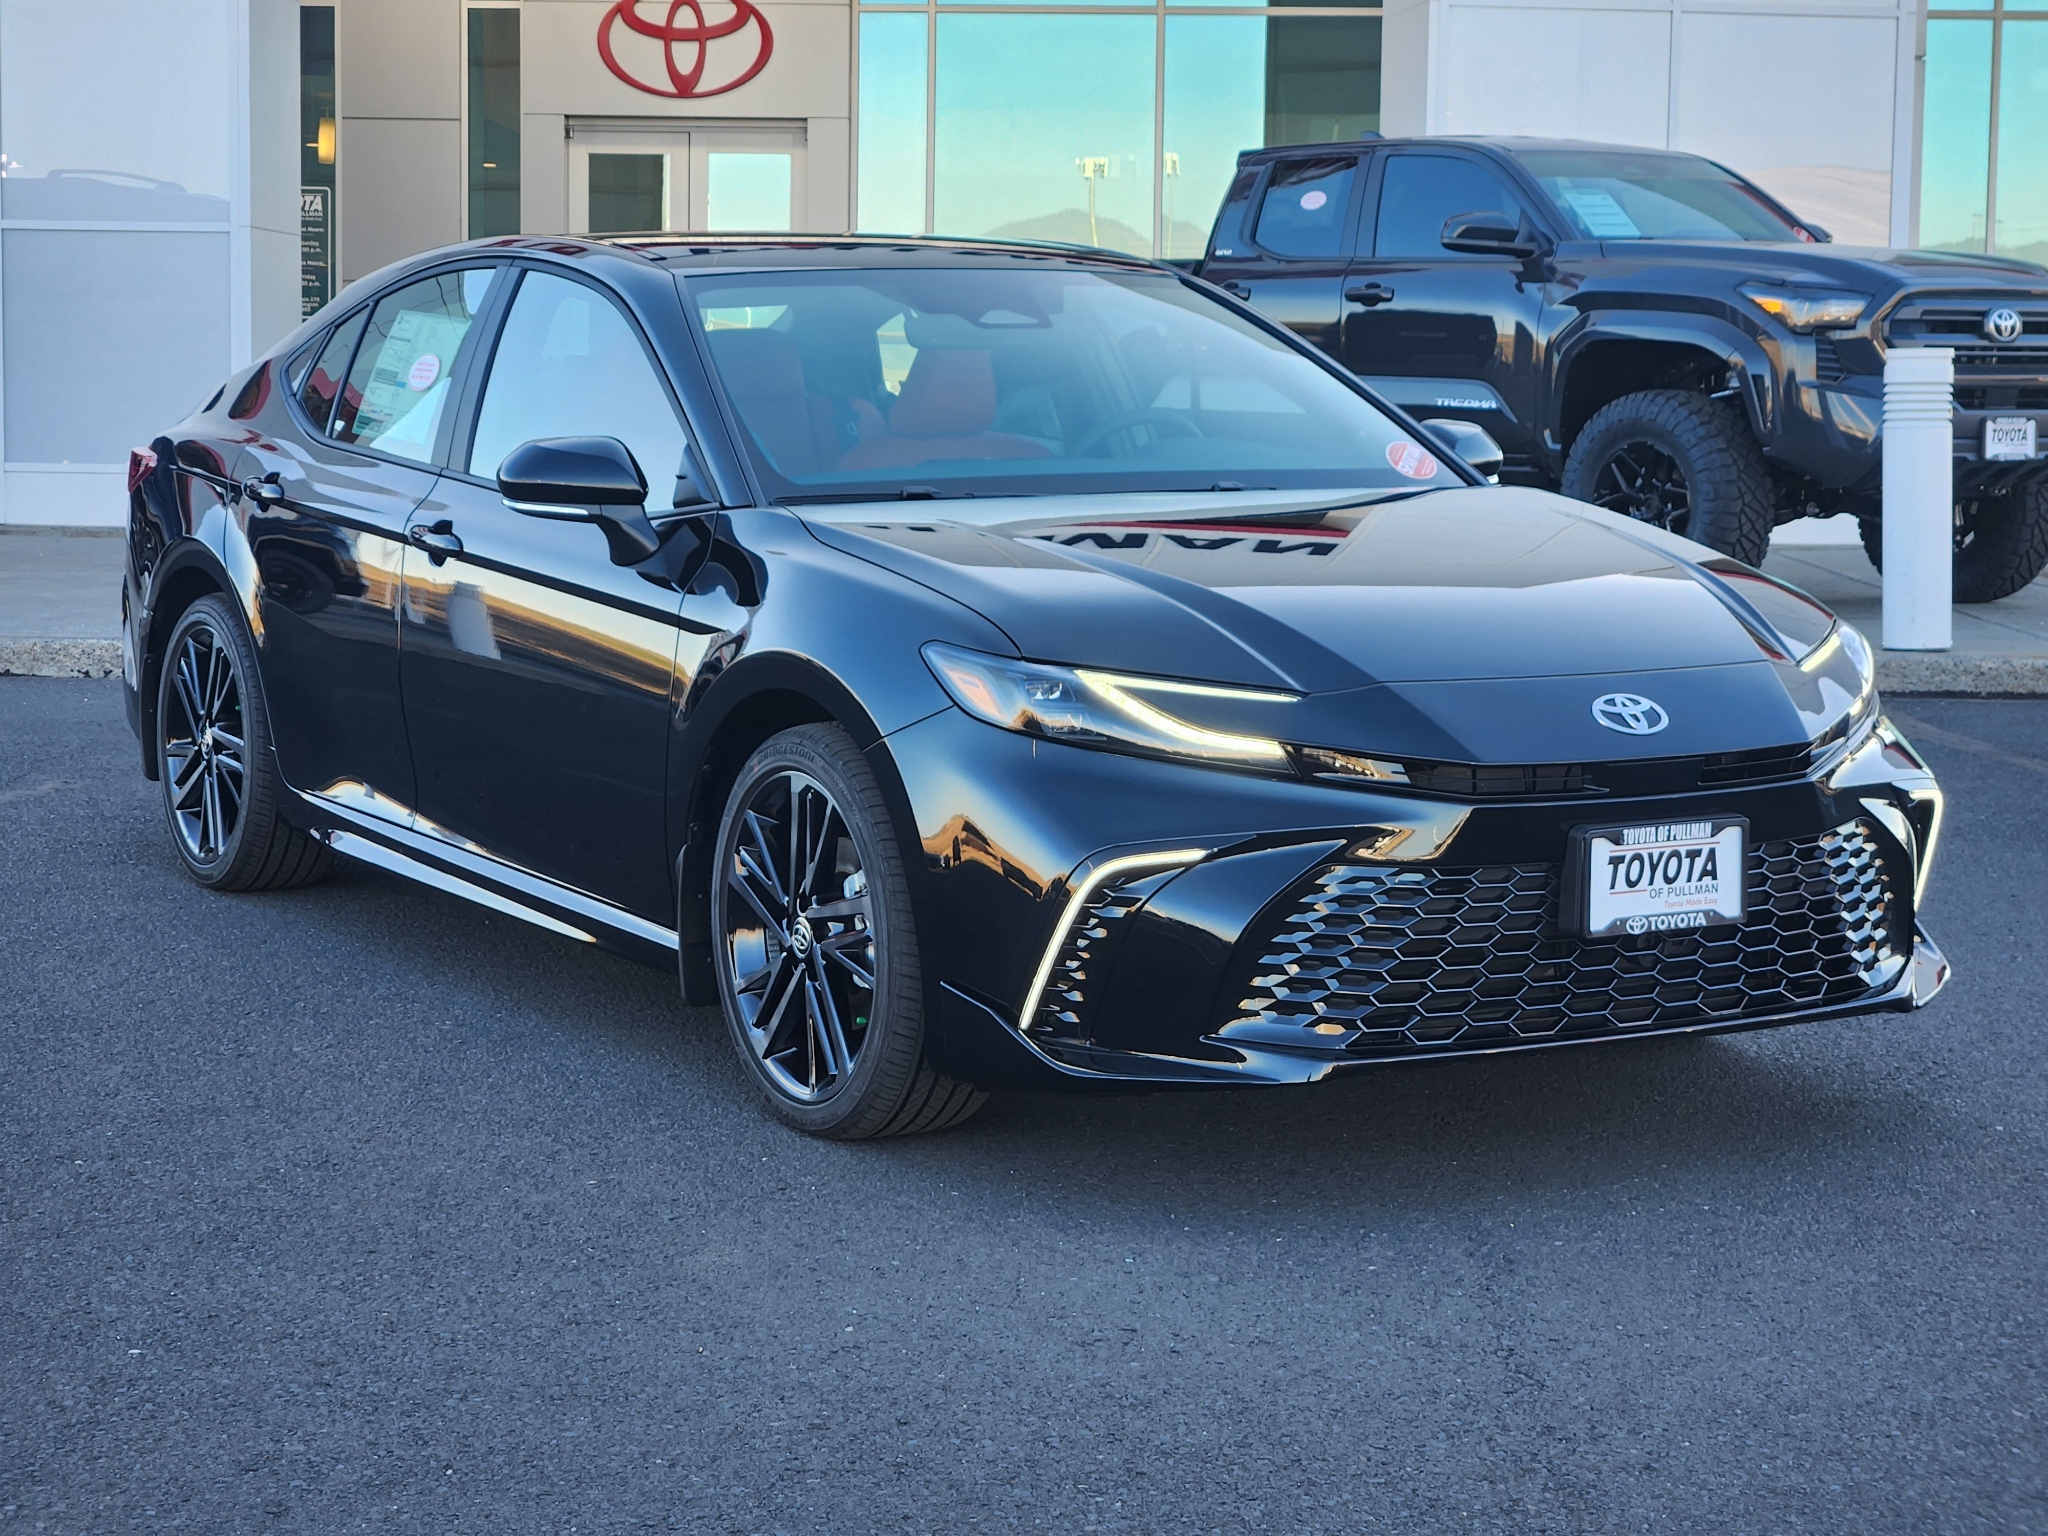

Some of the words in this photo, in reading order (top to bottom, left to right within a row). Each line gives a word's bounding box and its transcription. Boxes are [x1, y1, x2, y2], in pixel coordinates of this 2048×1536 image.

[1435, 398, 1497, 409] TACOMA
[1992, 427, 2027, 442] TOYOTA
[1623, 827, 1656, 845] TOYOTA
[1657, 825, 1670, 842] OF
[1670, 822, 1712, 840] PULLMAN
[1607, 847, 1718, 891] TOYOTA
[1649, 888, 1664, 899] OF
[1667, 883, 1719, 898] PULLMAN
[1664, 900, 1683, 909] Toyota
[1685, 898, 1703, 906] Made
[1704, 896, 1718, 906] Easy
[1648, 911, 1707, 931] TOYOTA
